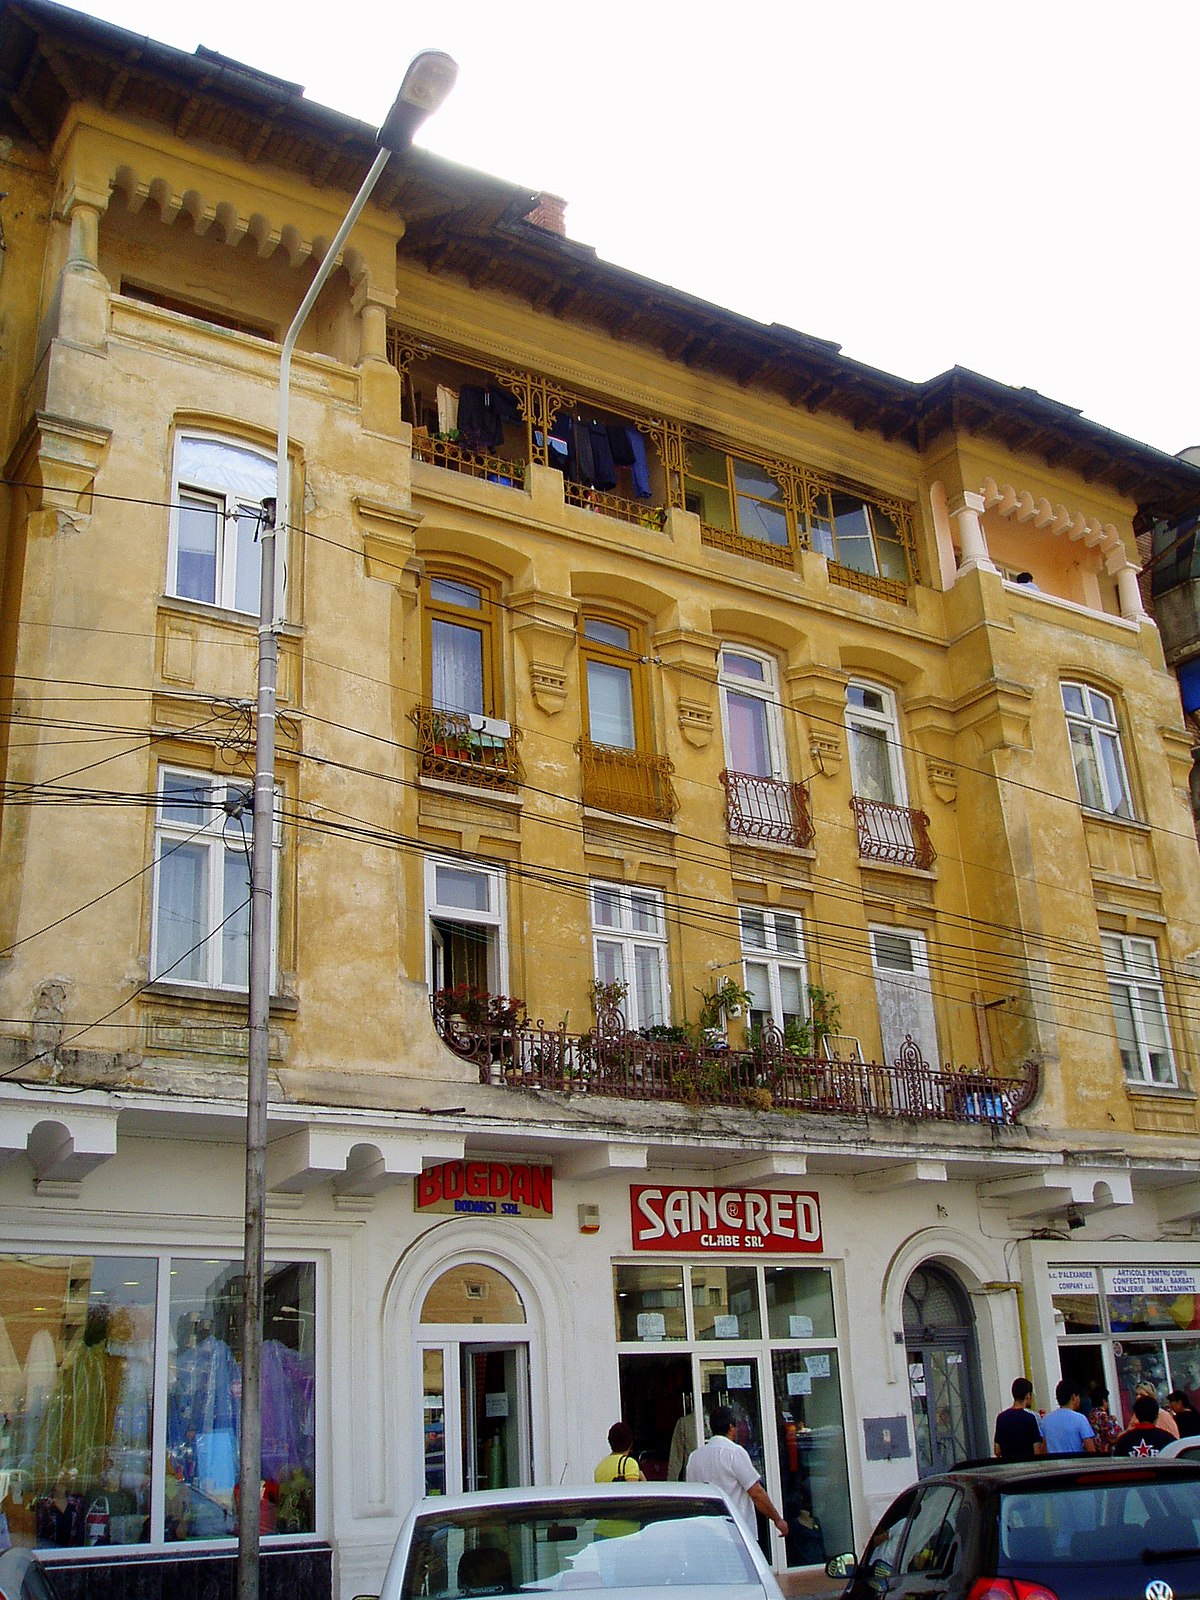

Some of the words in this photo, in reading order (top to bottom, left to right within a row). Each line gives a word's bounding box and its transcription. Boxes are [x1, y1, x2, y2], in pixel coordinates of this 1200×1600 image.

[417, 1160, 553, 1214] BOGDAN
[501, 1202, 521, 1214] SRL
[637, 1189, 820, 1242] SANCRED
[700, 1234, 740, 1247] CLABE
[744, 1235, 765, 1248] SRL
[1117, 1269, 1147, 1277] ARTICOLE
[1147, 1269, 1171, 1277] PENTRU
[1058, 1282, 1084, 1290] COMPANY
[1112, 1277, 1146, 1285] CONFECTII
[1146, 1277, 1165, 1285] DAMA
[1170, 1277, 1196, 1285] BARBATI
[1114, 1285, 1145, 1293] LENJERIE
[1151, 1285, 1197, 1293] INCALTAMINTE
